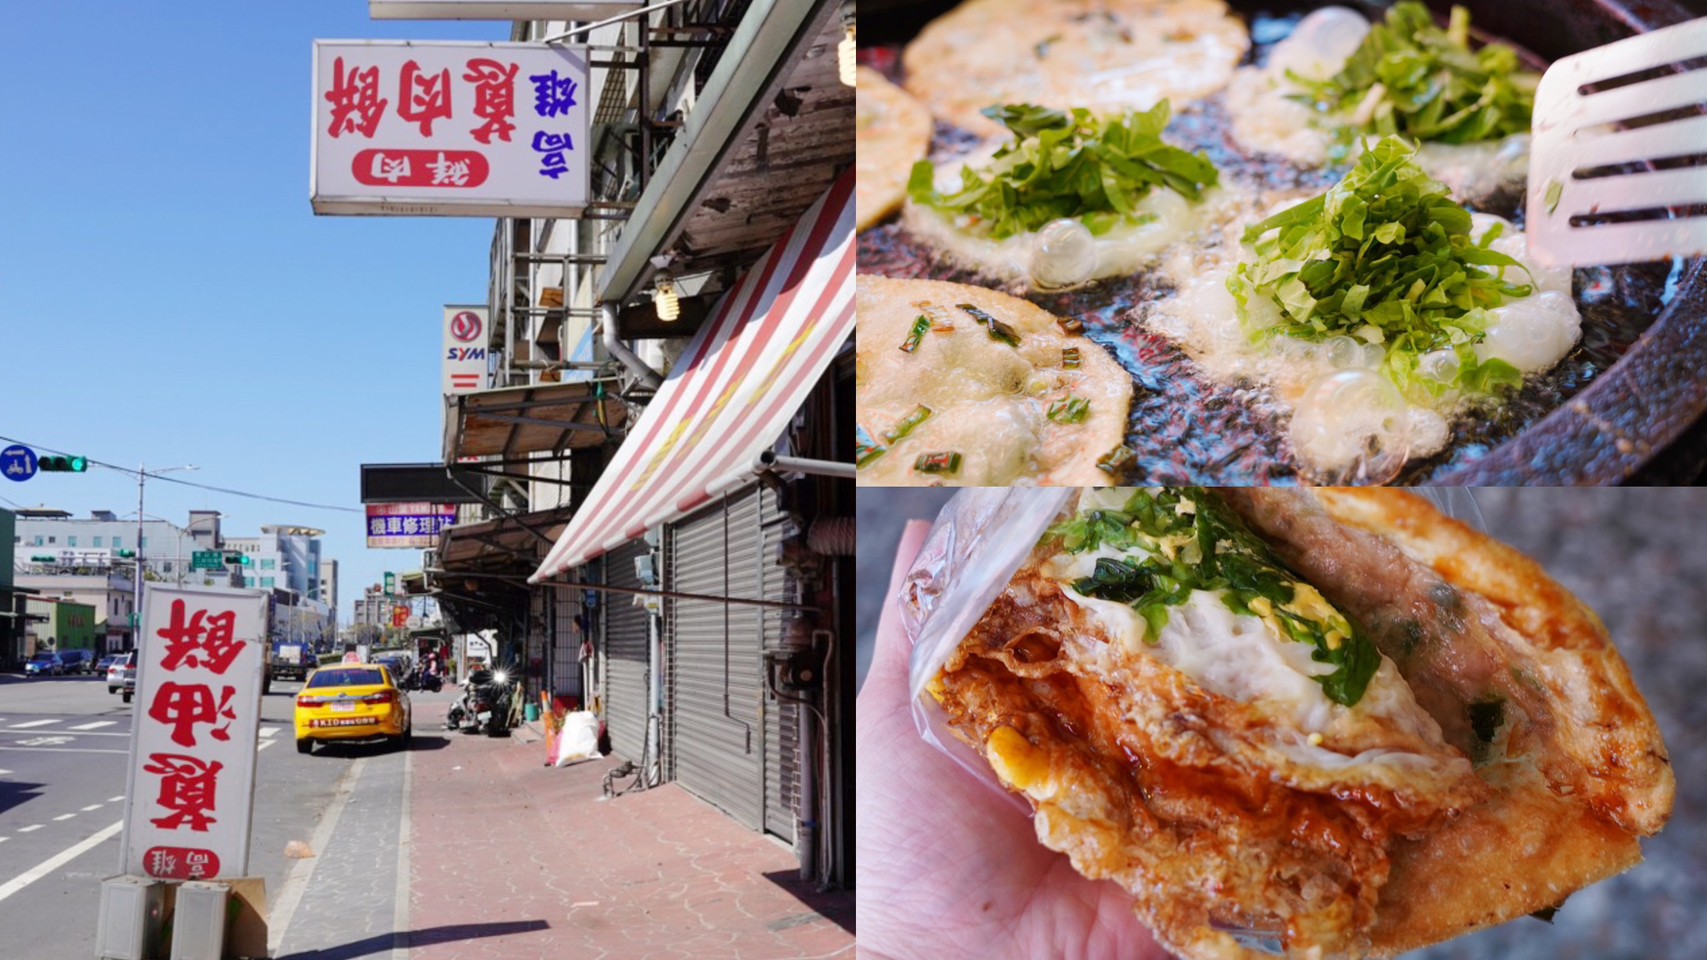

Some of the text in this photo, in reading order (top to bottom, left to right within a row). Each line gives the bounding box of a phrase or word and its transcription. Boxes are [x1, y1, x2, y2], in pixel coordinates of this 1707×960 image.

[324, 56, 520, 145] 蔥肉餅
[529, 69, 578, 180] 高雄
[370, 151, 471, 187] 鮮肉
[447, 347, 485, 361] SYM
[142, 598, 247, 832] 蔥油餅
[150, 849, 210, 877] 高雄
